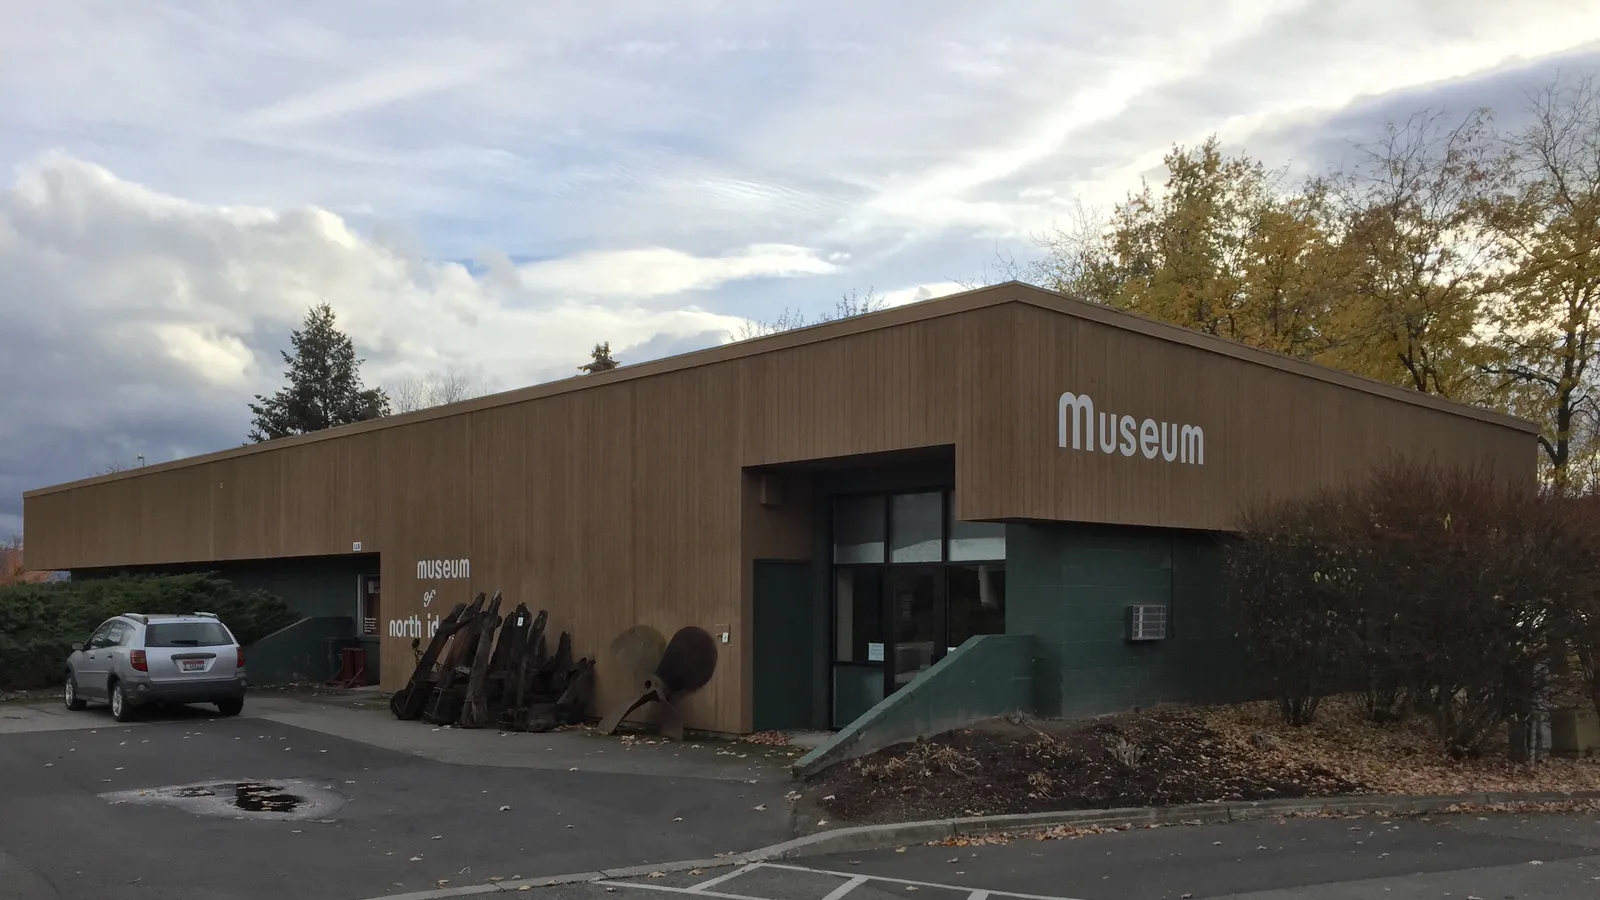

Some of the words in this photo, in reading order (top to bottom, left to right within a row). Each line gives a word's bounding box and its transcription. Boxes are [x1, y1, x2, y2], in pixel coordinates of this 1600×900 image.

[417, 558, 470, 579] museum
[423, 589, 436, 608] of
[389, 614, 422, 638] north
